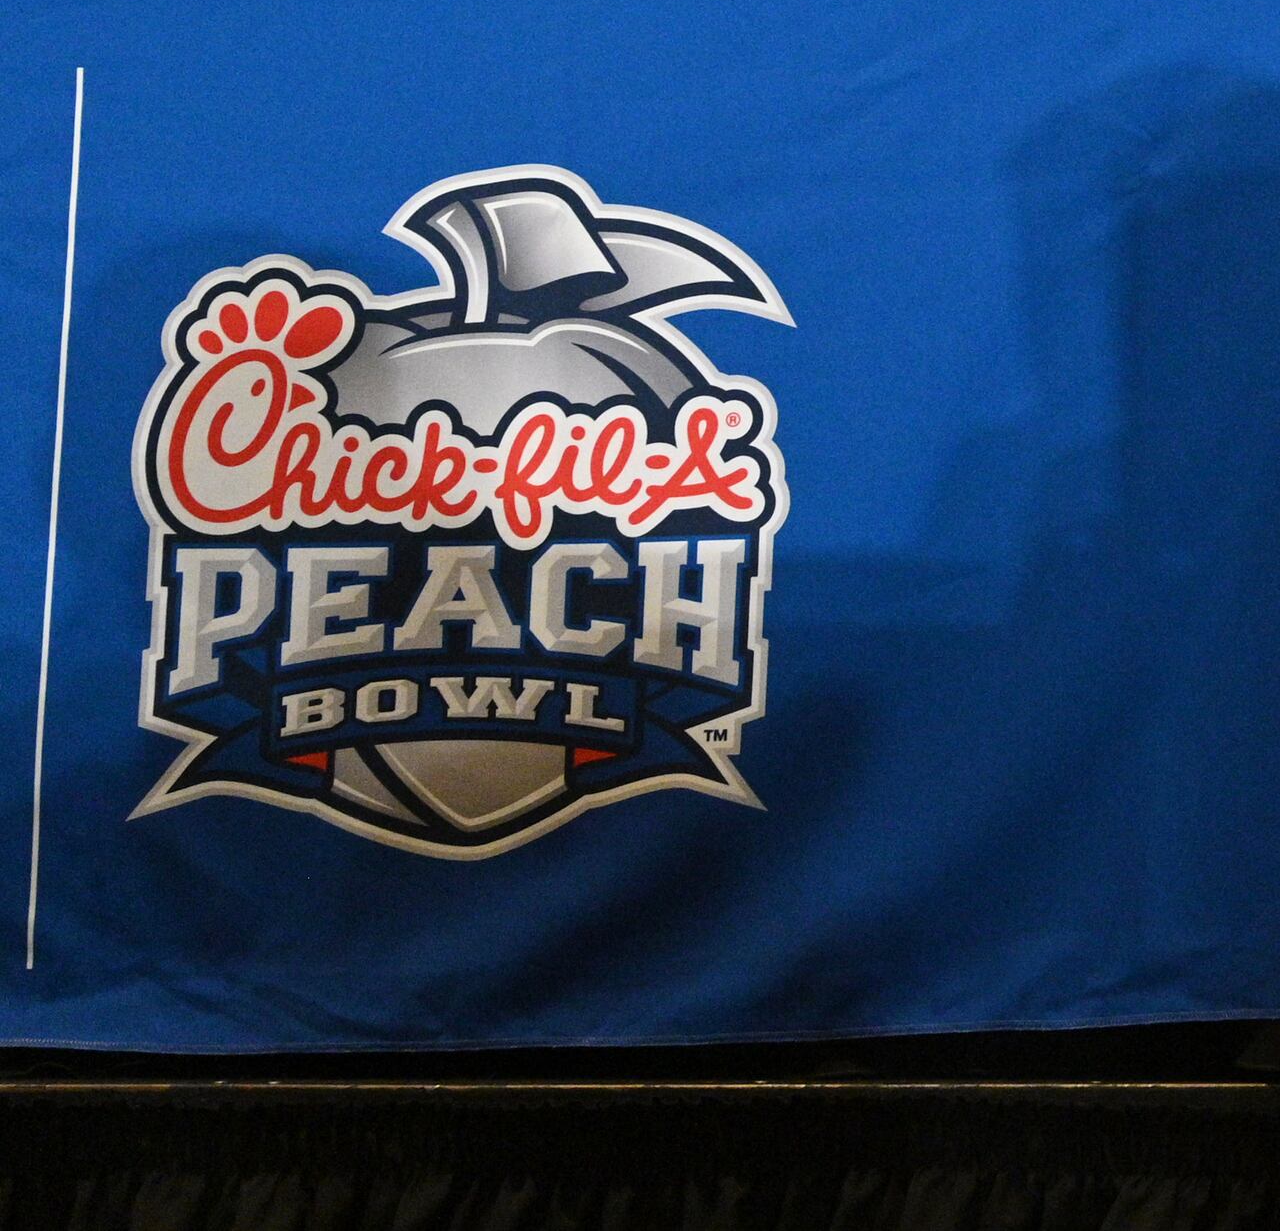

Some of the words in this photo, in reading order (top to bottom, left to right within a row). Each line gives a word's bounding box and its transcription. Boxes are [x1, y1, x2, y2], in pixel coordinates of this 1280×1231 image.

[168, 348, 752, 538] Chick-fil-A
[169, 539, 745, 695] PEACH
[281, 676, 624, 736] BOWL
